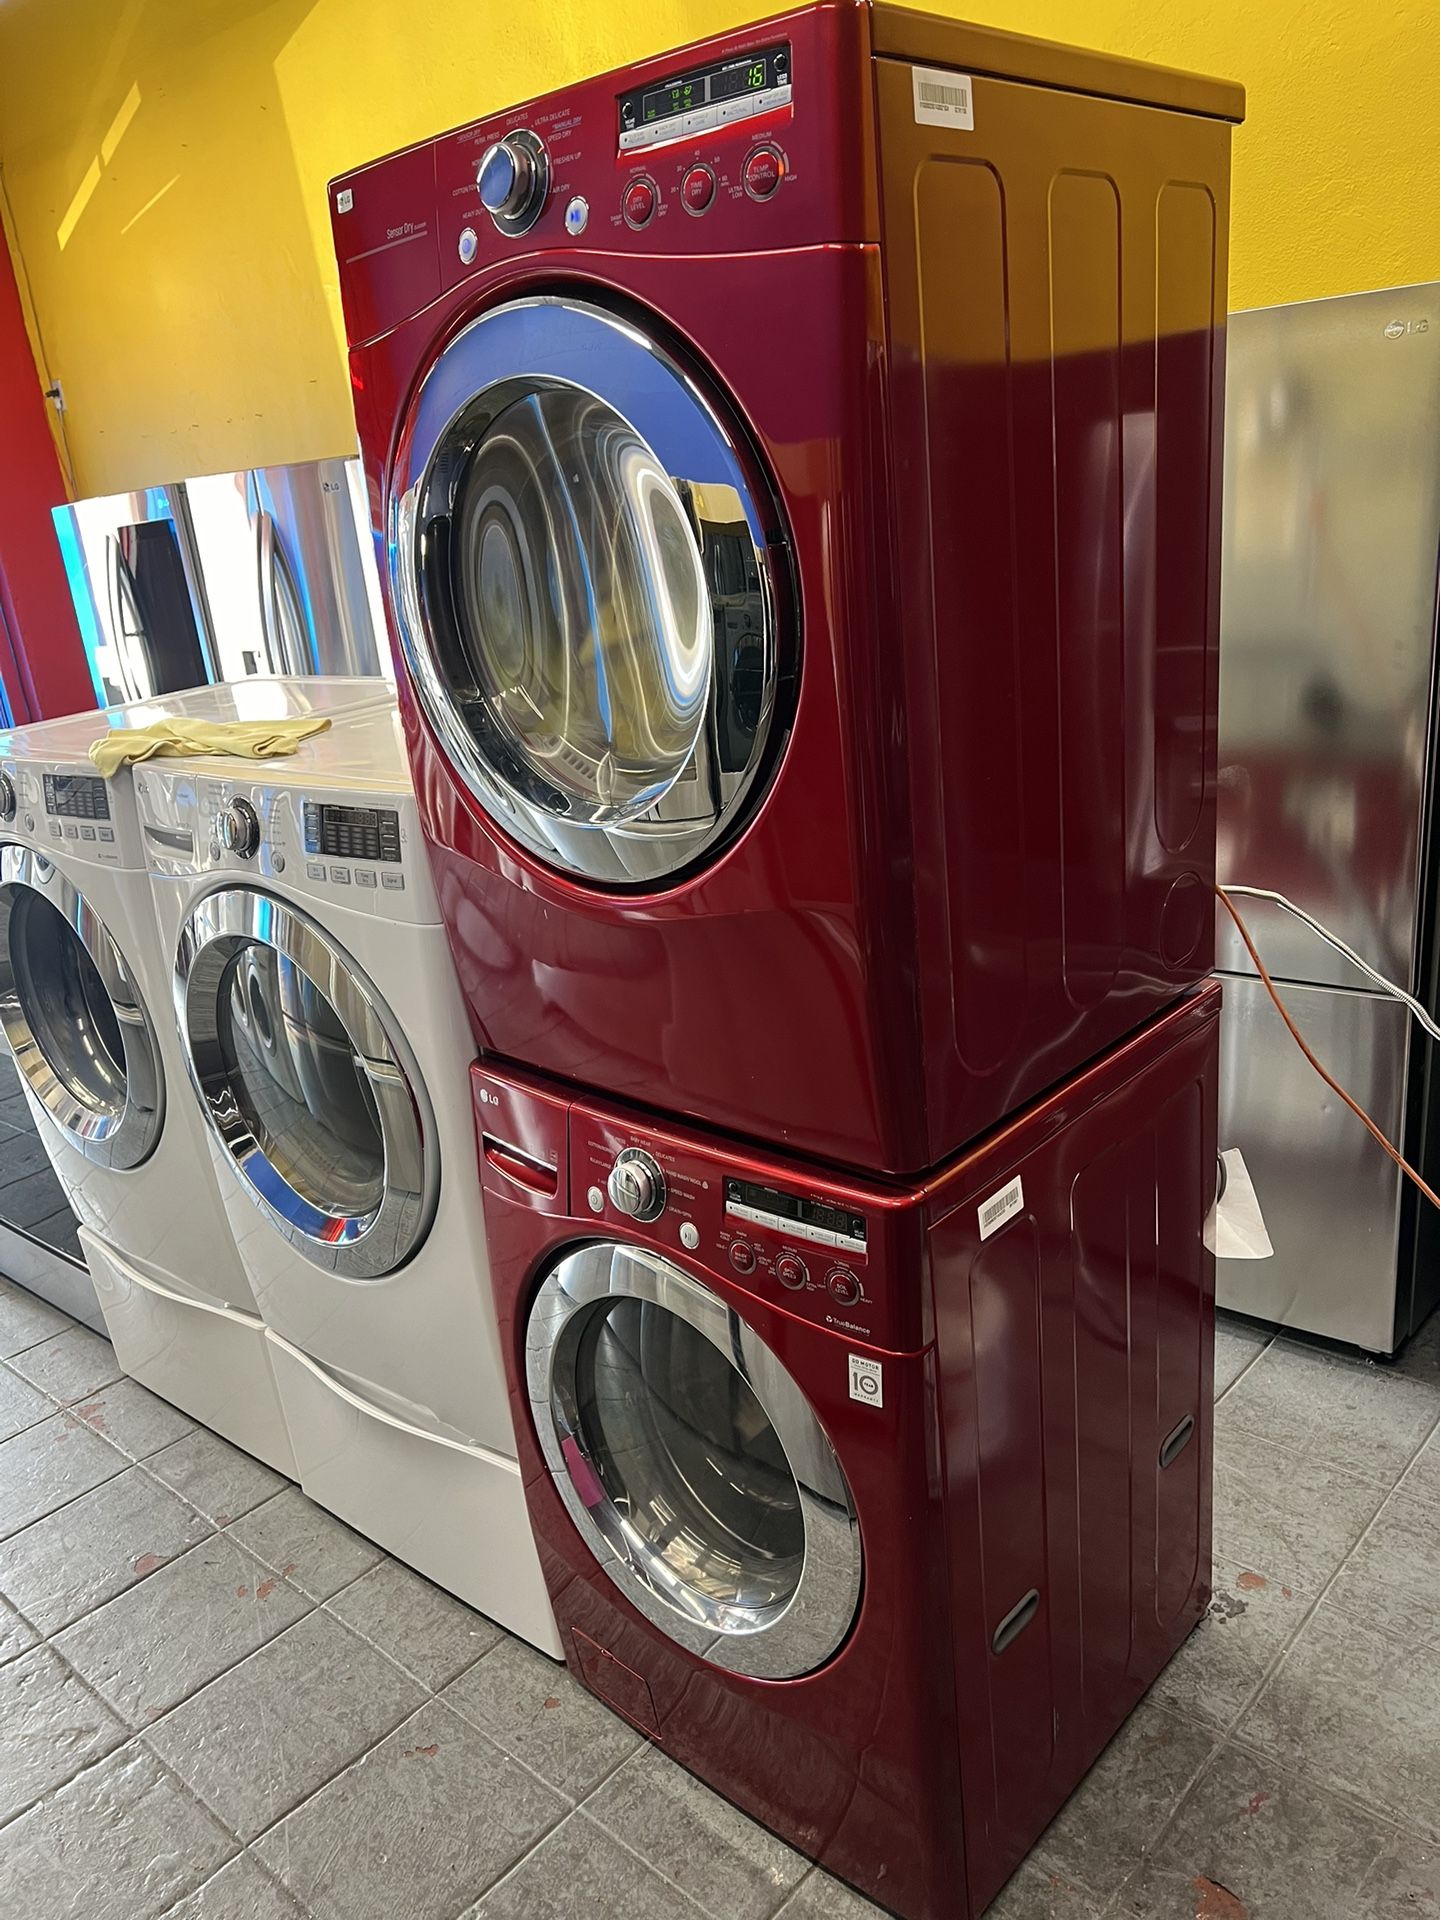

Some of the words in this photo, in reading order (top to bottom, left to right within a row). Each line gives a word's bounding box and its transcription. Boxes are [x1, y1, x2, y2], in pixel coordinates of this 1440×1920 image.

[748, 64, 763, 85] 16
[506, 112, 529, 126] DELICATES
[549, 108, 571, 122] DELICATE
[561, 130, 572, 139] DRY
[752, 131, 773, 141] MEDIUM
[749, 170, 776, 183] CONTROL
[784, 174, 798, 183] HIGH
[690, 181, 703, 190] TIME
[691, 188, 702, 197] DRY
[630, 201, 646, 212] LEVEL
[386, 224, 404, 240] Sensor
[403, 222, 415, 235] Dry
[1406, 319, 1429, 335] LG
[833, 1317, 871, 1335] TrueBalance
